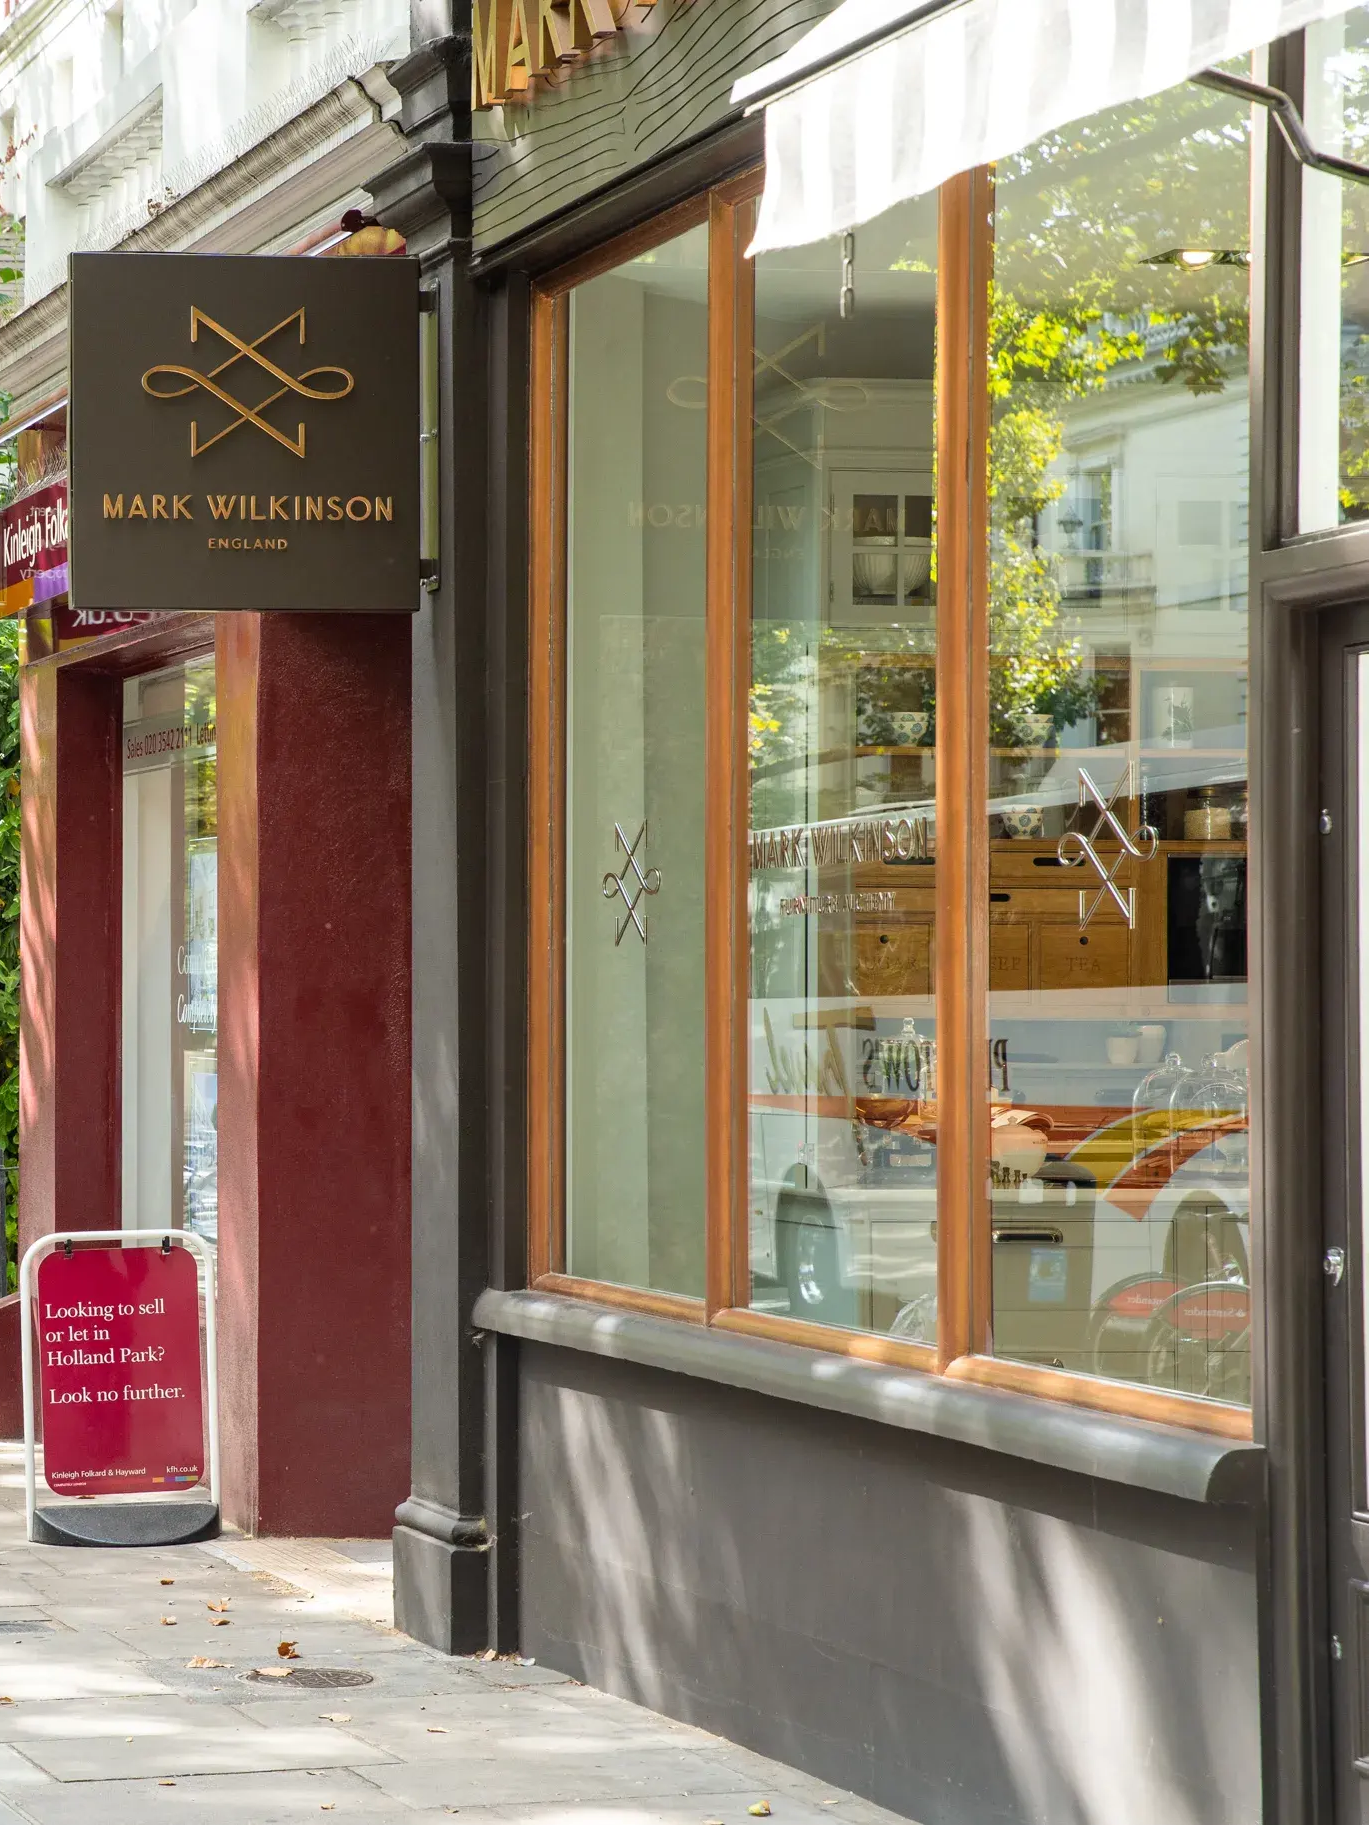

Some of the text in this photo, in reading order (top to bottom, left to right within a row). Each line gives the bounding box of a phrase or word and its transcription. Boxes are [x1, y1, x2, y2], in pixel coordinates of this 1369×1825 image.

[103, 493, 394, 522] MARK WILKINSON
[4, 510, 42, 567] Kinleigh
[208, 537, 288, 551] ENGLAND
[127, 737, 143, 760] Sales
[144, 733, 157, 756] 020
[753, 816, 928, 869] MARK WILKINSON
[45, 1298, 165, 1321] Looking to sell
[46, 1325, 110, 1343] or let in
[47, 1346, 165, 1366] Holland Park?
[49, 1384, 186, 1405] Look no further.
[51, 1470, 79, 1480] Kinleigh
[81, 1469, 106, 1478] Folkard
[115, 1467, 146, 1477] Hayward
[166, 1465, 198, 1474] kfh.co.uk
